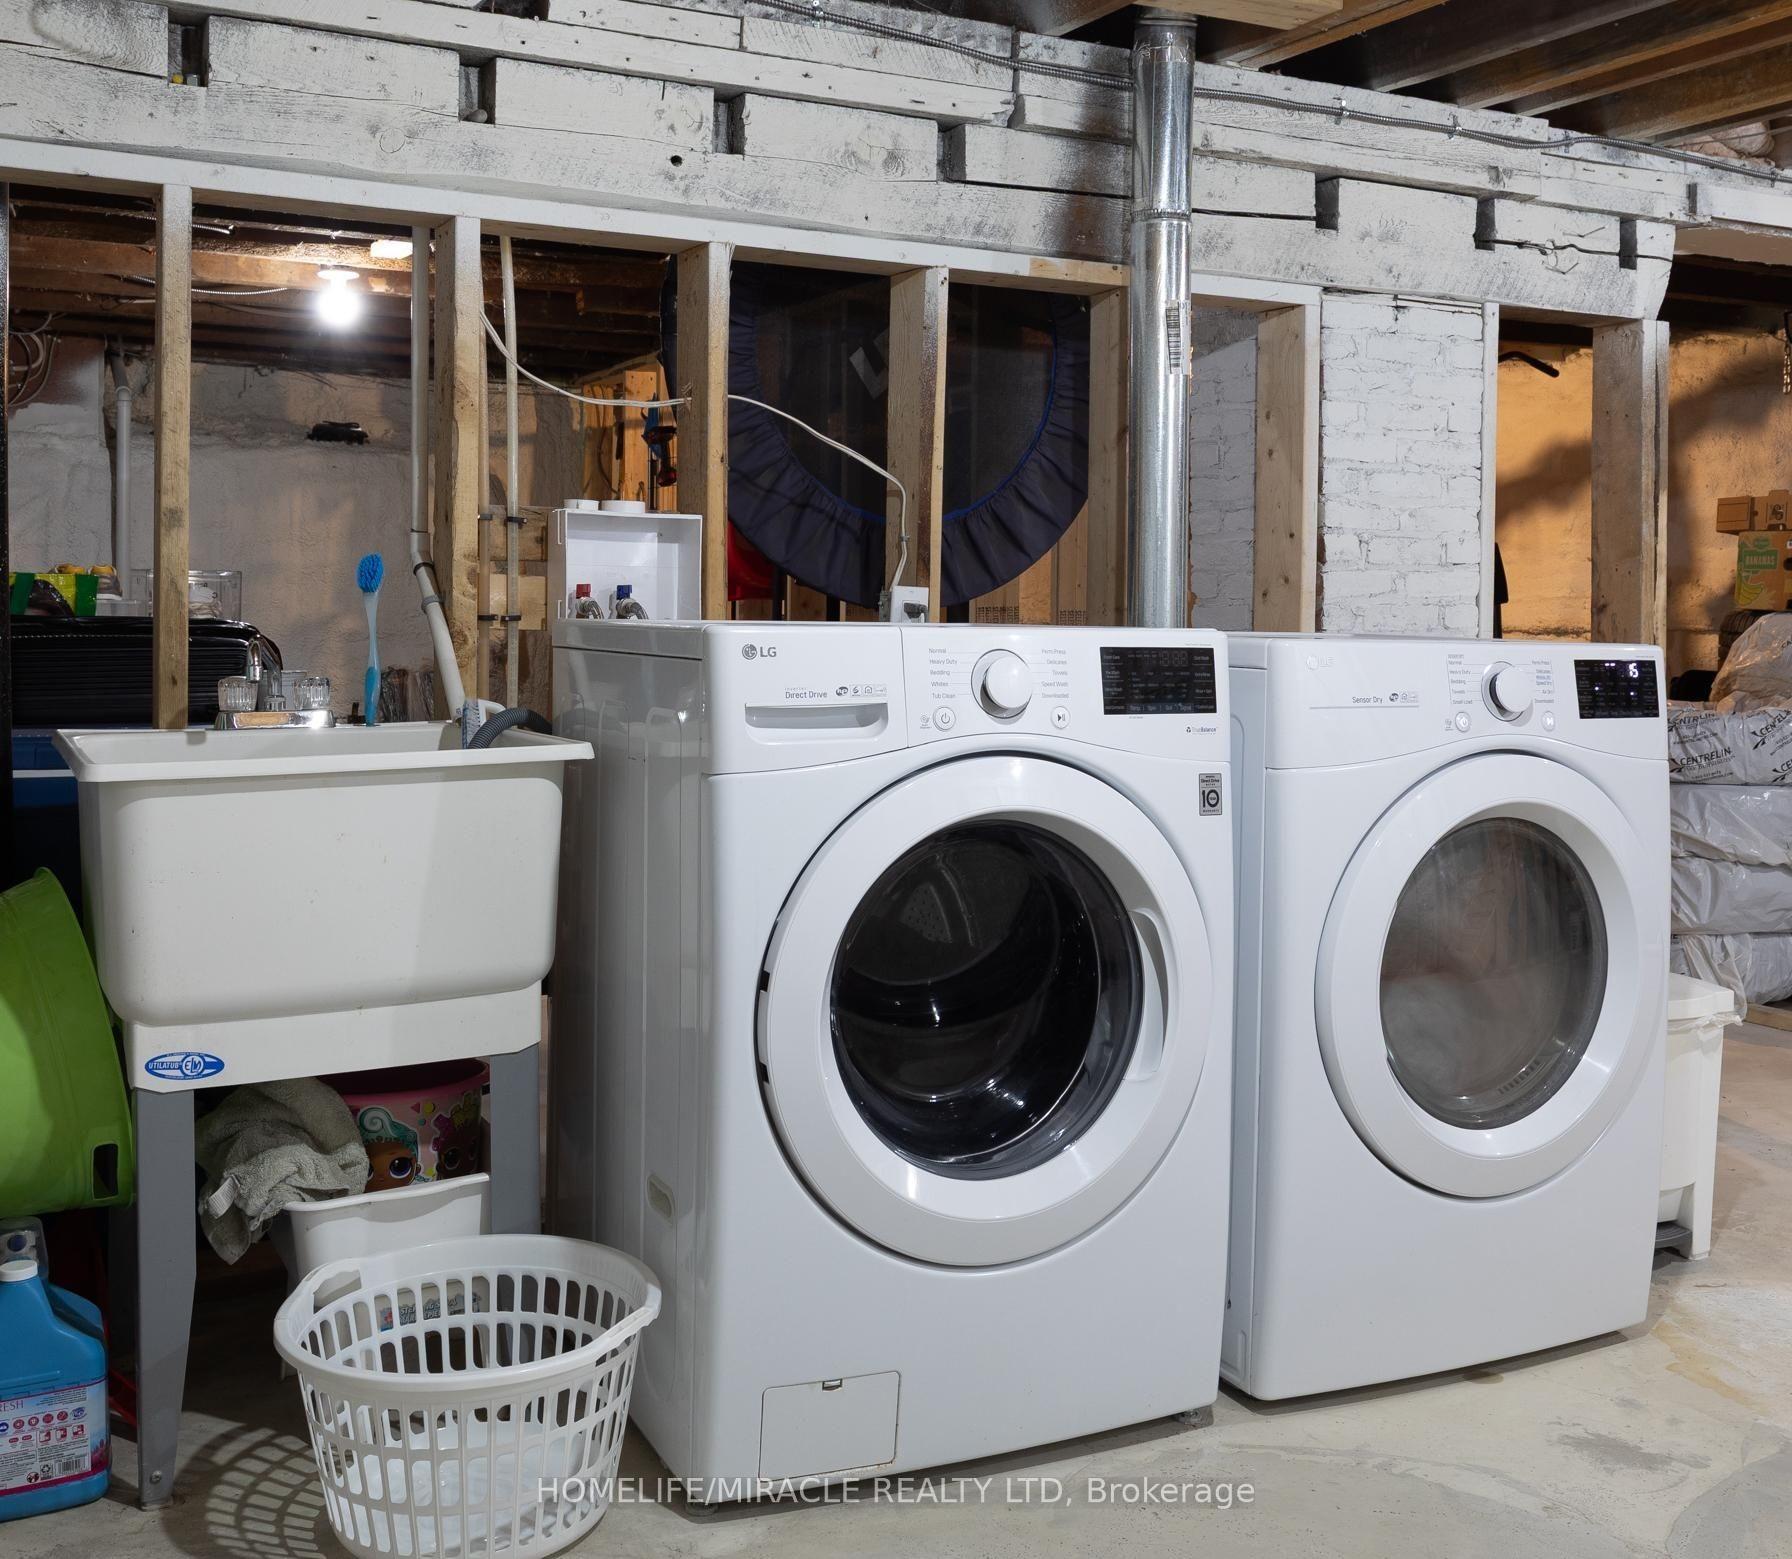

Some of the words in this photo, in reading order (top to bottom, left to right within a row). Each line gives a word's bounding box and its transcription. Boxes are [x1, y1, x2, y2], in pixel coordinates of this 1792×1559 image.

[759, 646, 777, 658] LG
[785, 691, 807, 699] Direct
[808, 690, 828, 698] Drive
[1372, 696, 1383, 704] Dry
[1202, 789, 1220, 808] 10
[148, 1061, 180, 1070] UTILATUB
